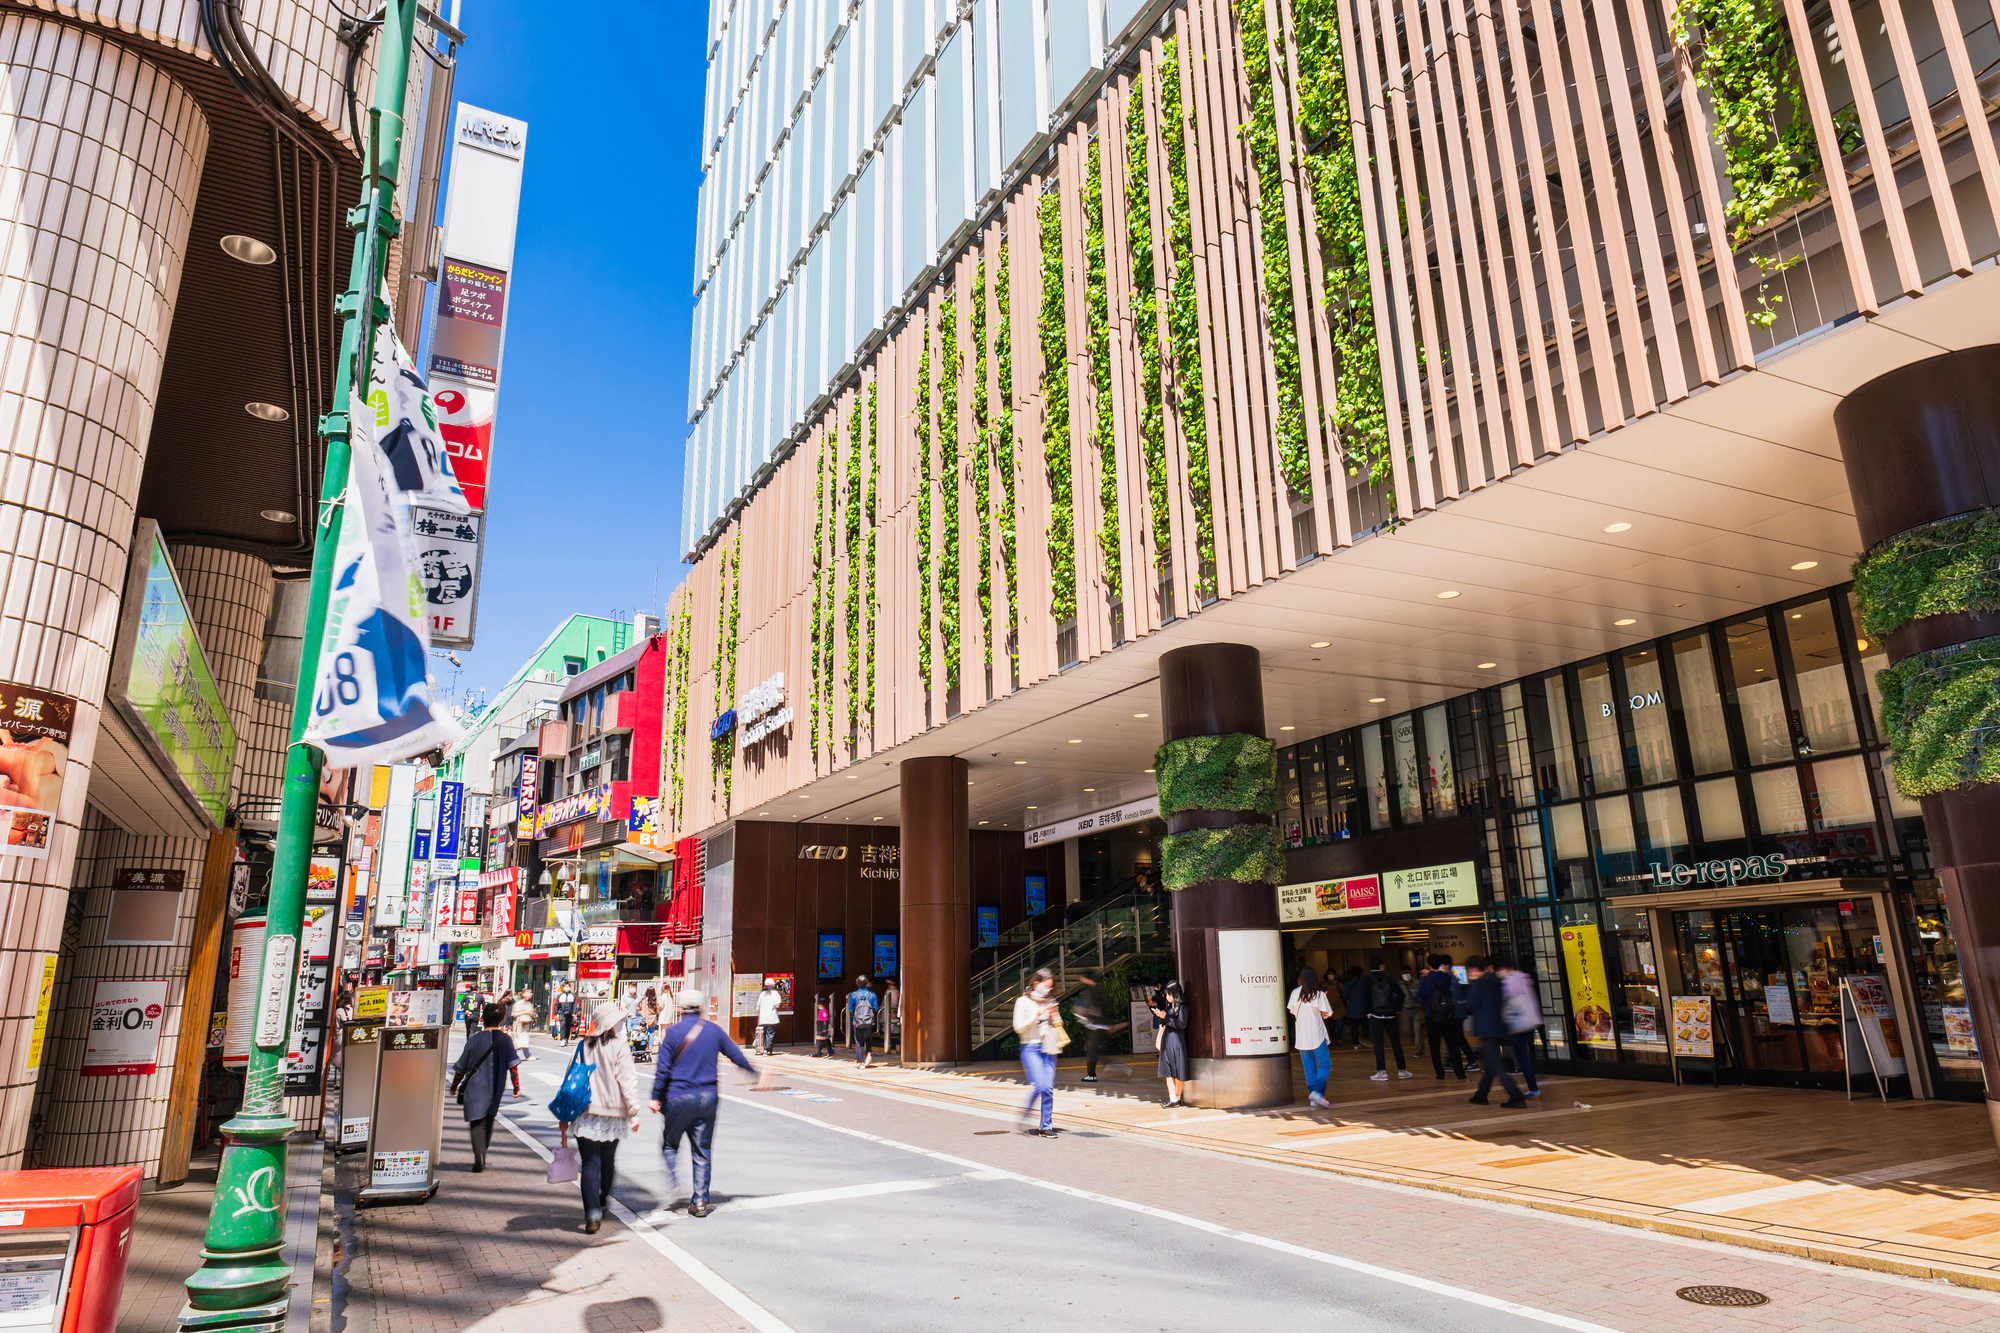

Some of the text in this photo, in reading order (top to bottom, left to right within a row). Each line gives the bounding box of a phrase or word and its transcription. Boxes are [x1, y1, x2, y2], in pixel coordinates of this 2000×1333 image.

[447, 304, 496, 321] アロマオイル
[416, 519, 476, 541] 梅一輪
[1602, 690, 1662, 717] BOM
[521, 758, 537, 812] カラオケ
[440, 785, 455, 848] アパマンショップ
[549, 794, 578, 825] カラオケ
[1078, 818, 1094, 831] KEIO
[1099, 810, 1123, 827] 吉祥寺駅
[1139, 808, 1154, 816] Station
[640, 832, 658, 846] B1
[799, 845, 848, 860] KEIO
[861, 845, 900, 864] 吉祥
[130, 872, 166, 884] 美源
[411, 866, 423, 888] 古本
[861, 867, 900, 880] Kichijō
[1407, 866, 1458, 883] 北口駅前広場
[1650, 852, 1788, 888] Le repas
[1350, 886, 1375, 898] DAISO
[452, 928, 479, 939] ねぎし
[580, 945, 615, 954] カラオケ
[1576, 931, 1593, 1001] 吉祥寺カレーパン
[393, 1033, 426, 1045] 美源
[374, 1159, 385, 1169] 4F
